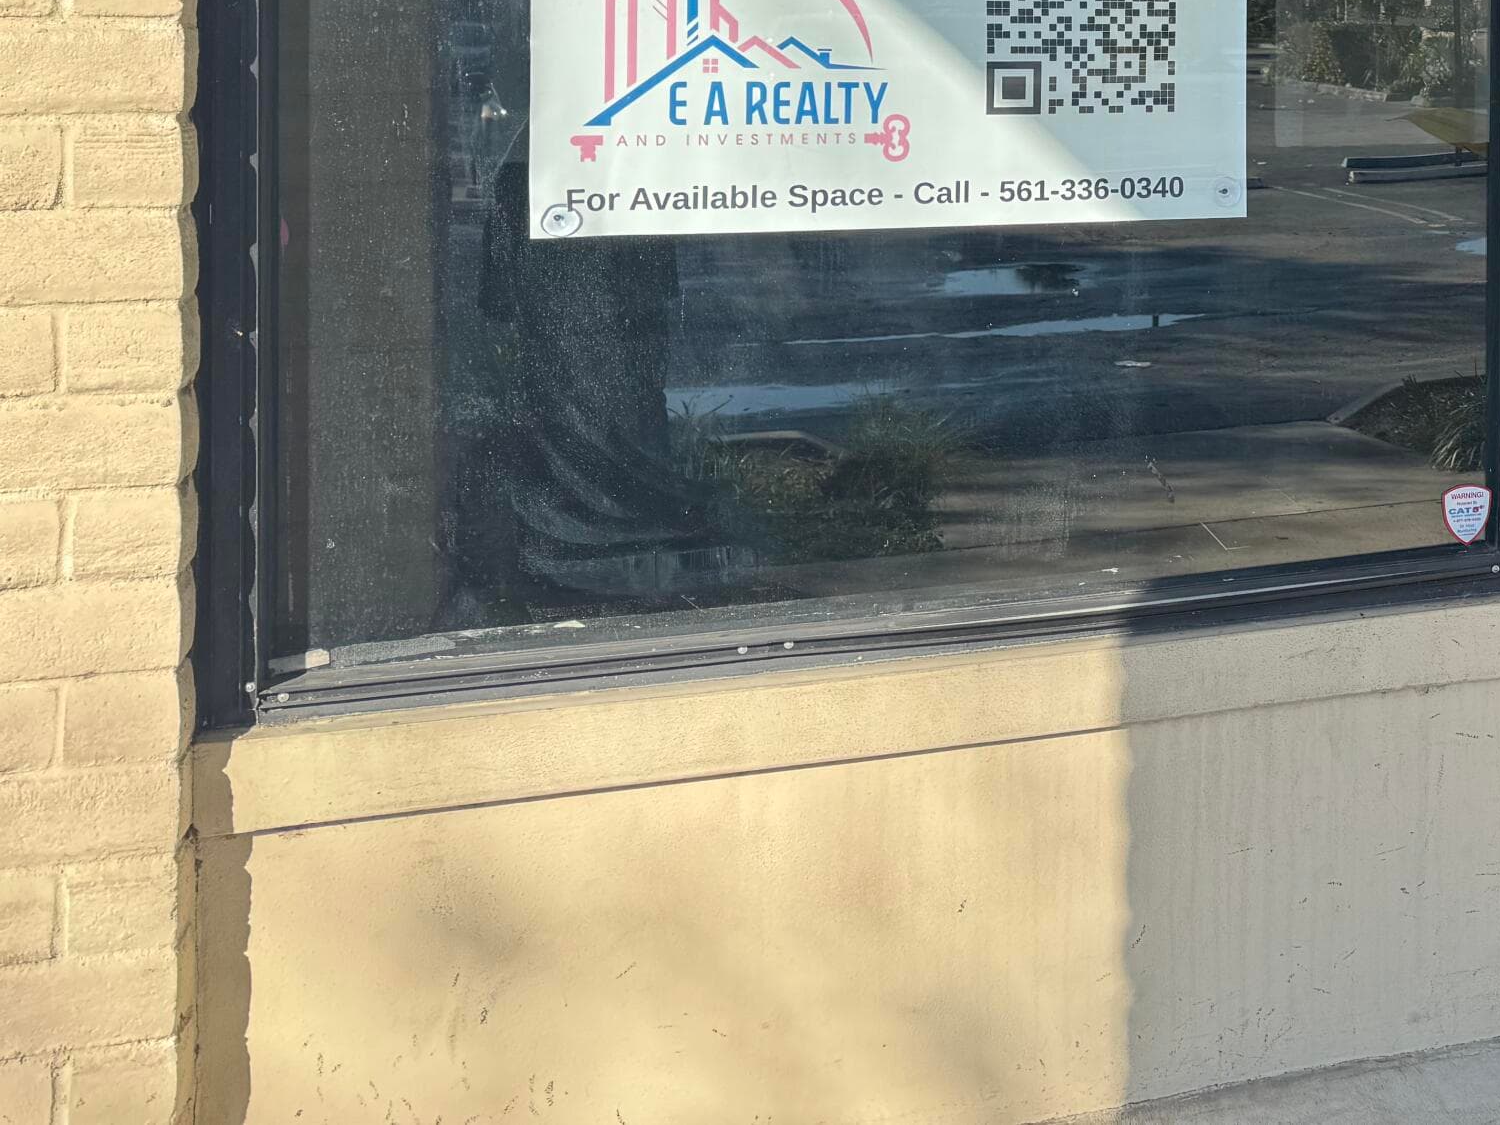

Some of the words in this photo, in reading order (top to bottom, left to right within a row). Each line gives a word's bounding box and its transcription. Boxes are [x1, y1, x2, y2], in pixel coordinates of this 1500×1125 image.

[668, 81, 687, 125] E
[703, 81, 729, 125] A
[745, 81, 889, 125] REALTY
[616, 135, 666, 146] AND
[686, 133, 856, 146] INVESTMENTS
[566, 188, 620, 212] For
[629, 185, 777, 211] Available
[787, 184, 883, 213] Space
[914, 180, 969, 204] Call
[999, 176, 1184, 202] 561-336-0340
